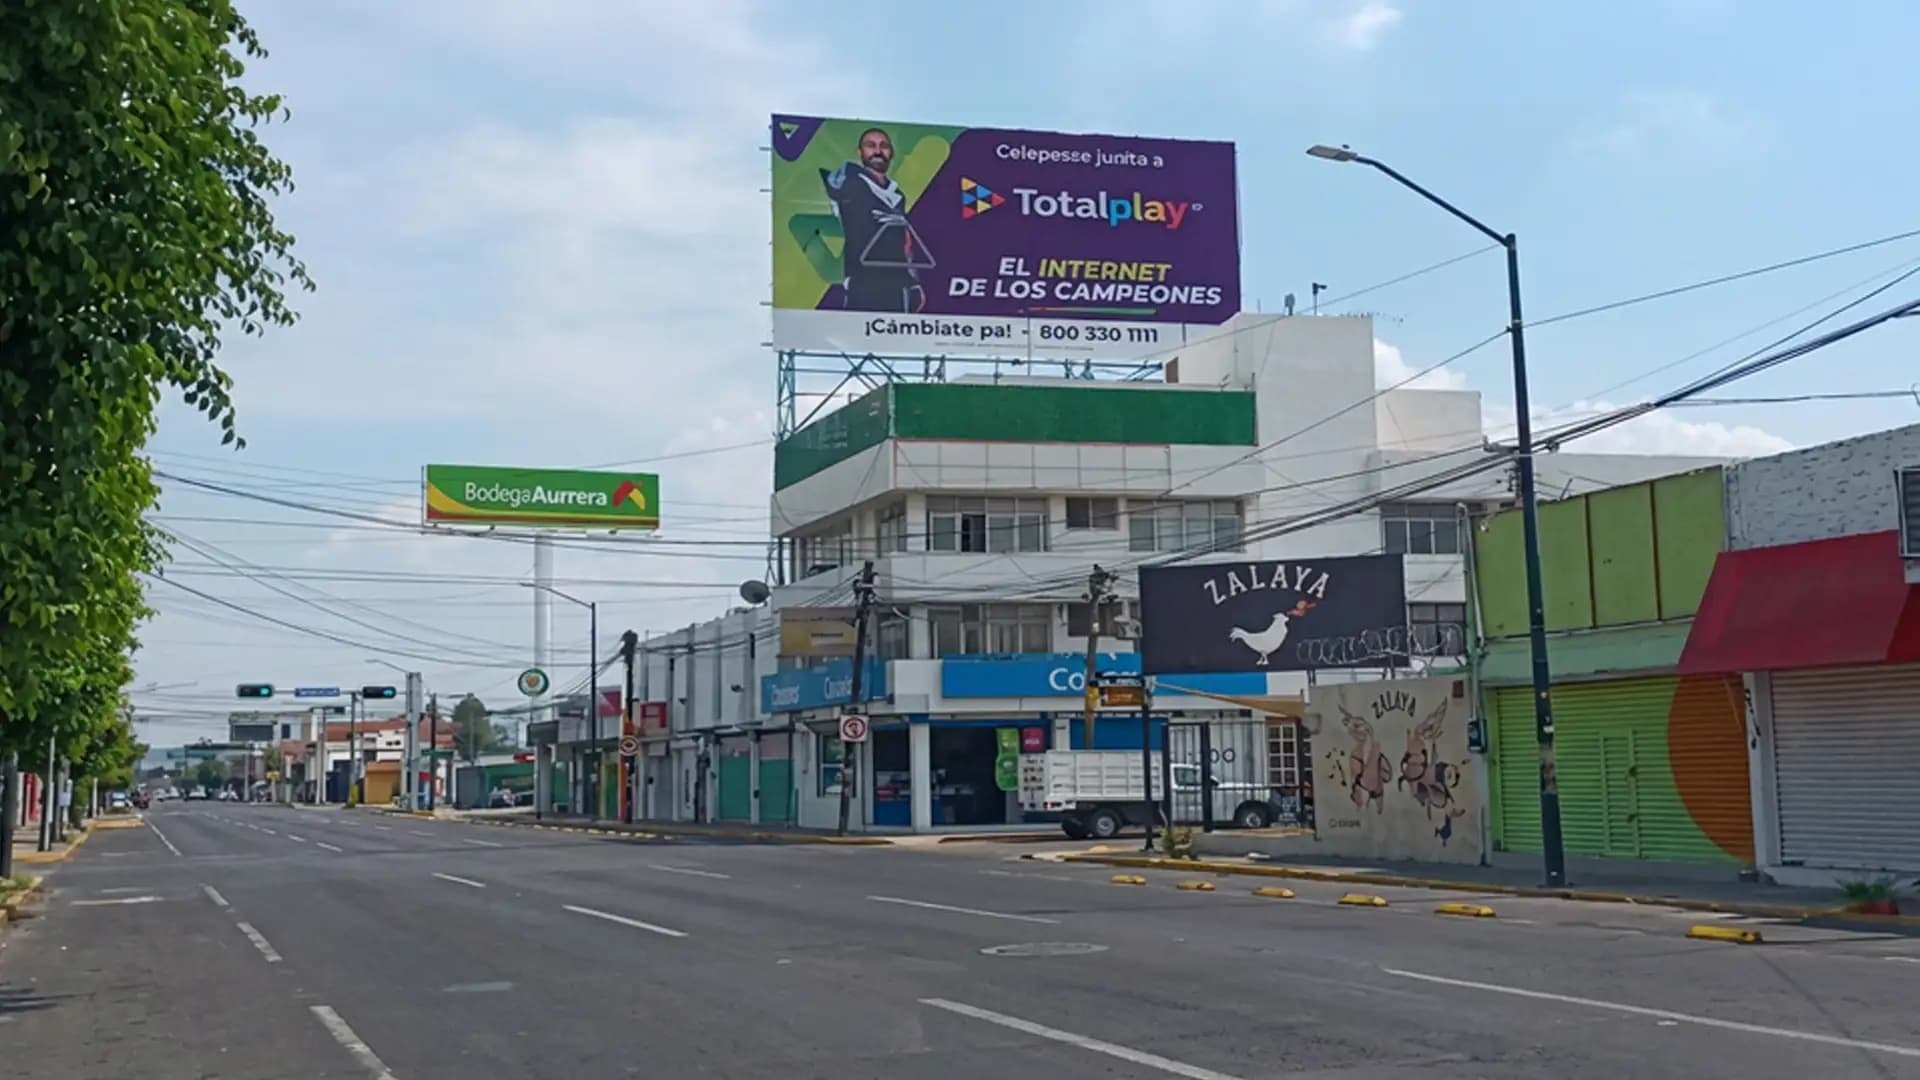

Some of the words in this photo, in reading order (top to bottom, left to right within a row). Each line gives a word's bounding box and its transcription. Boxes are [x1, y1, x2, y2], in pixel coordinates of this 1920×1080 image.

[996, 144, 1092, 164] Celepesse
[1095, 148, 1148, 167] junita
[1153, 156, 1164, 168] a
[1013, 187, 1188, 229] Totalplay
[998, 256, 1031, 277] EL
[1038, 259, 1172, 282] INTERNET
[949, 277, 988, 297] DE
[994, 279, 1047, 299] LOS
[1054, 283, 1222, 305] CAMPEONES
[865, 318, 974, 337] ¡Cámbiate
[980, 323, 1012, 341] pa!
[1039, 325, 1080, 341] 800
[1084, 326, 1122, 342] 330
[1128, 327, 1158, 343] 1111
[1203, 564, 1330, 605] ZALAYA
